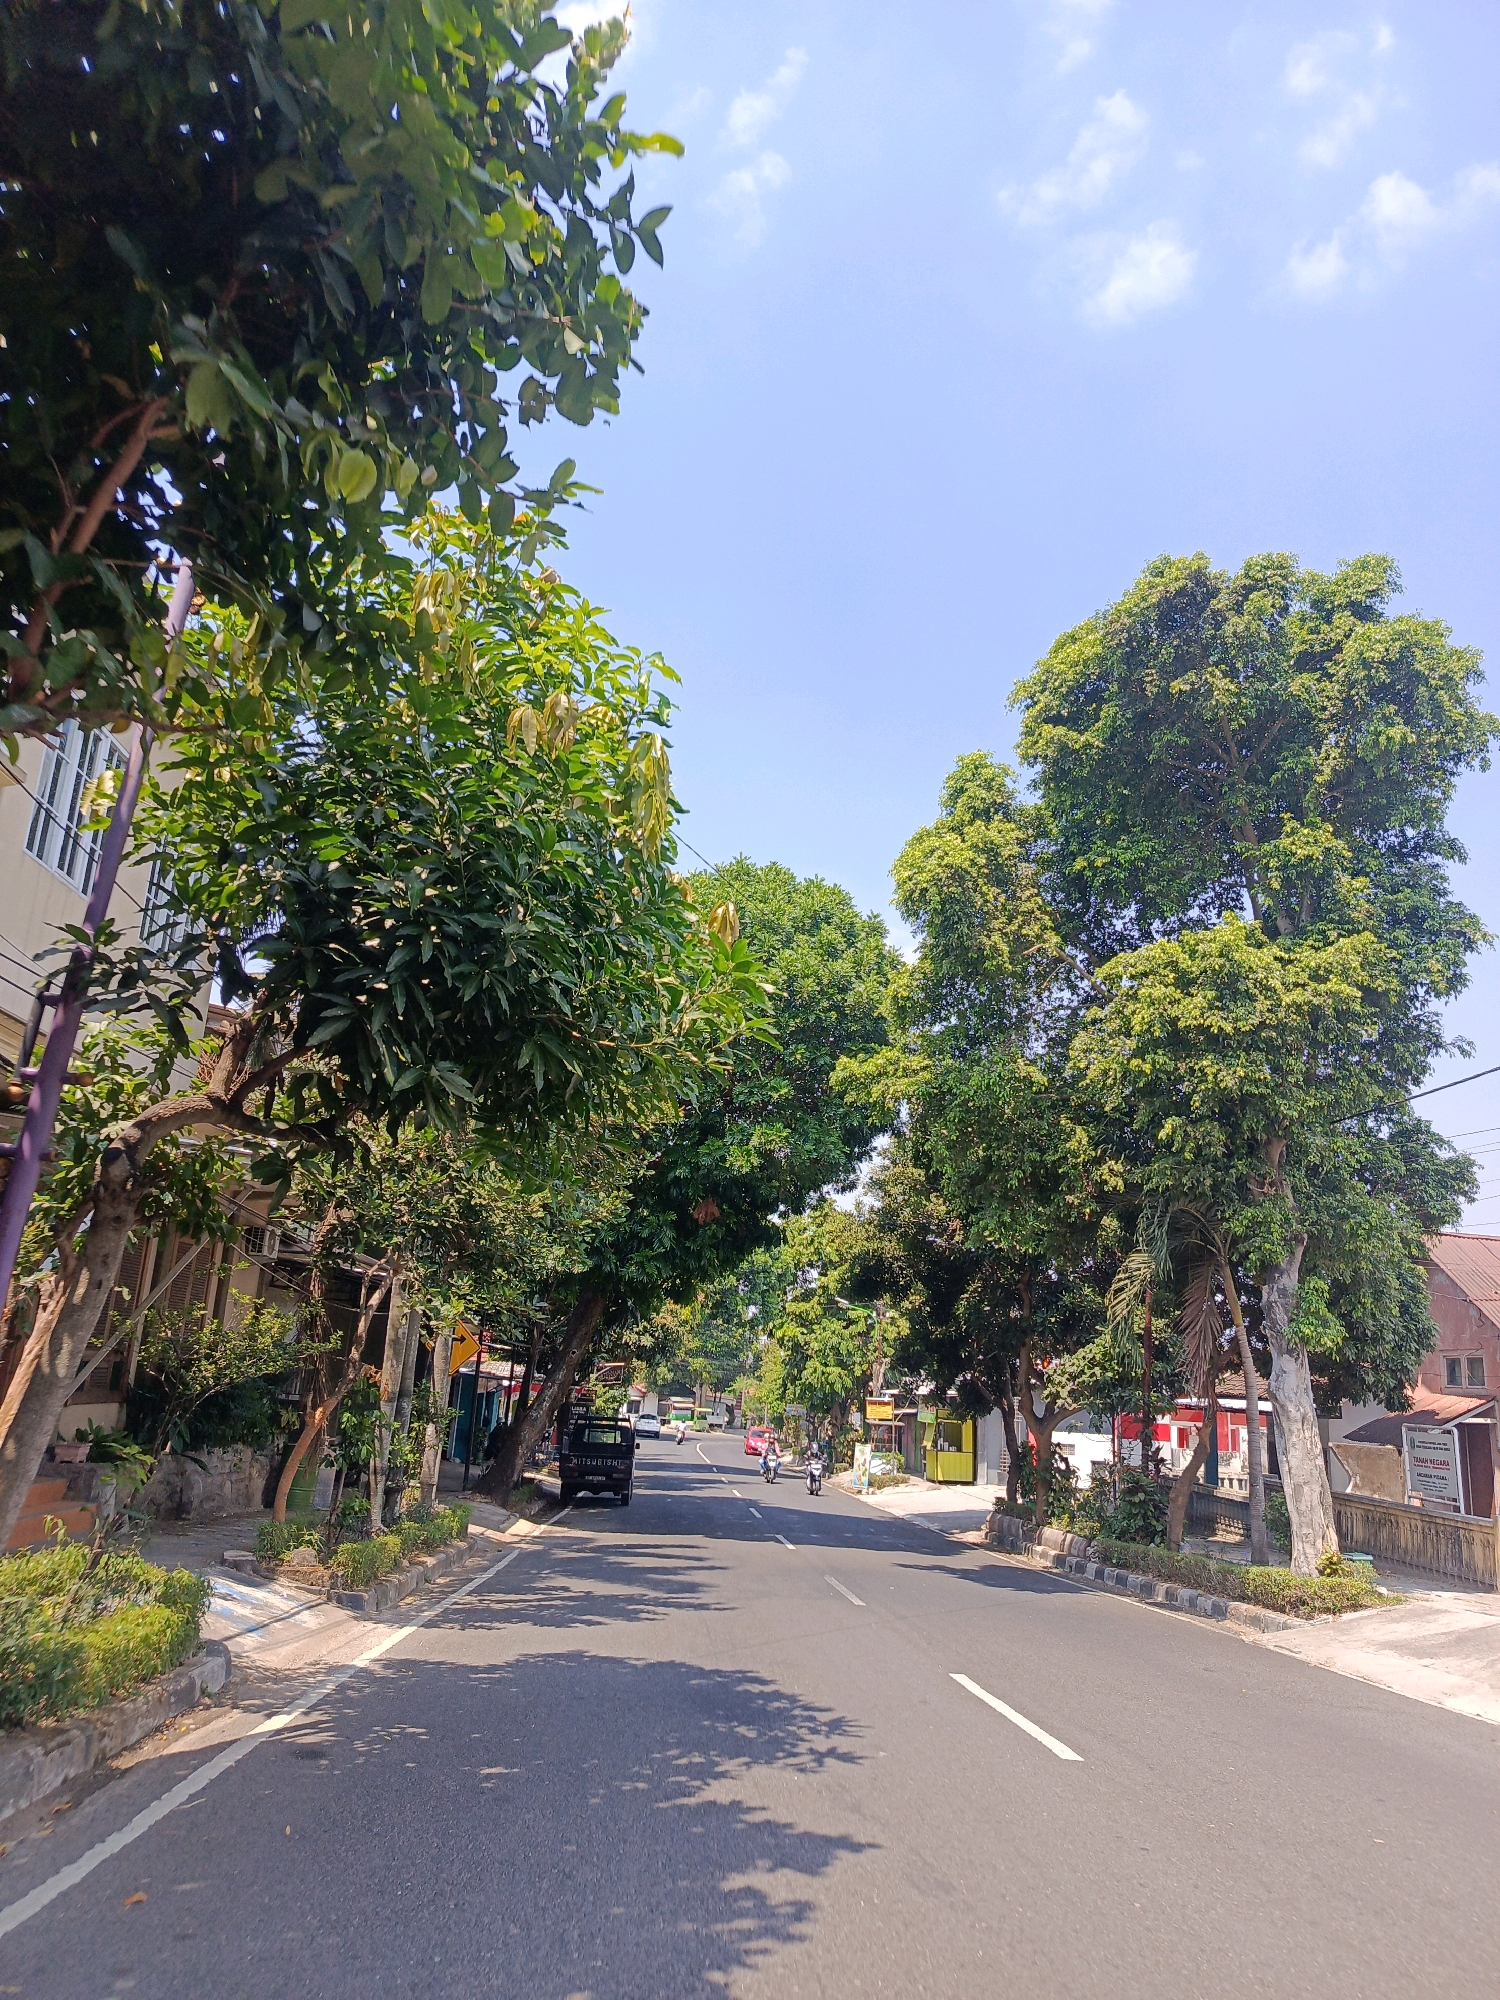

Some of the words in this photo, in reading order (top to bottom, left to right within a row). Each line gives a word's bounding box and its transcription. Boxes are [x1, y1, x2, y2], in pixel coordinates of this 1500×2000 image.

[570, 1456, 621, 1466] MITSUBISHI
[1412, 1456, 1428, 1464] TANAH
[1429, 1458, 1450, 1466] NEGARA
